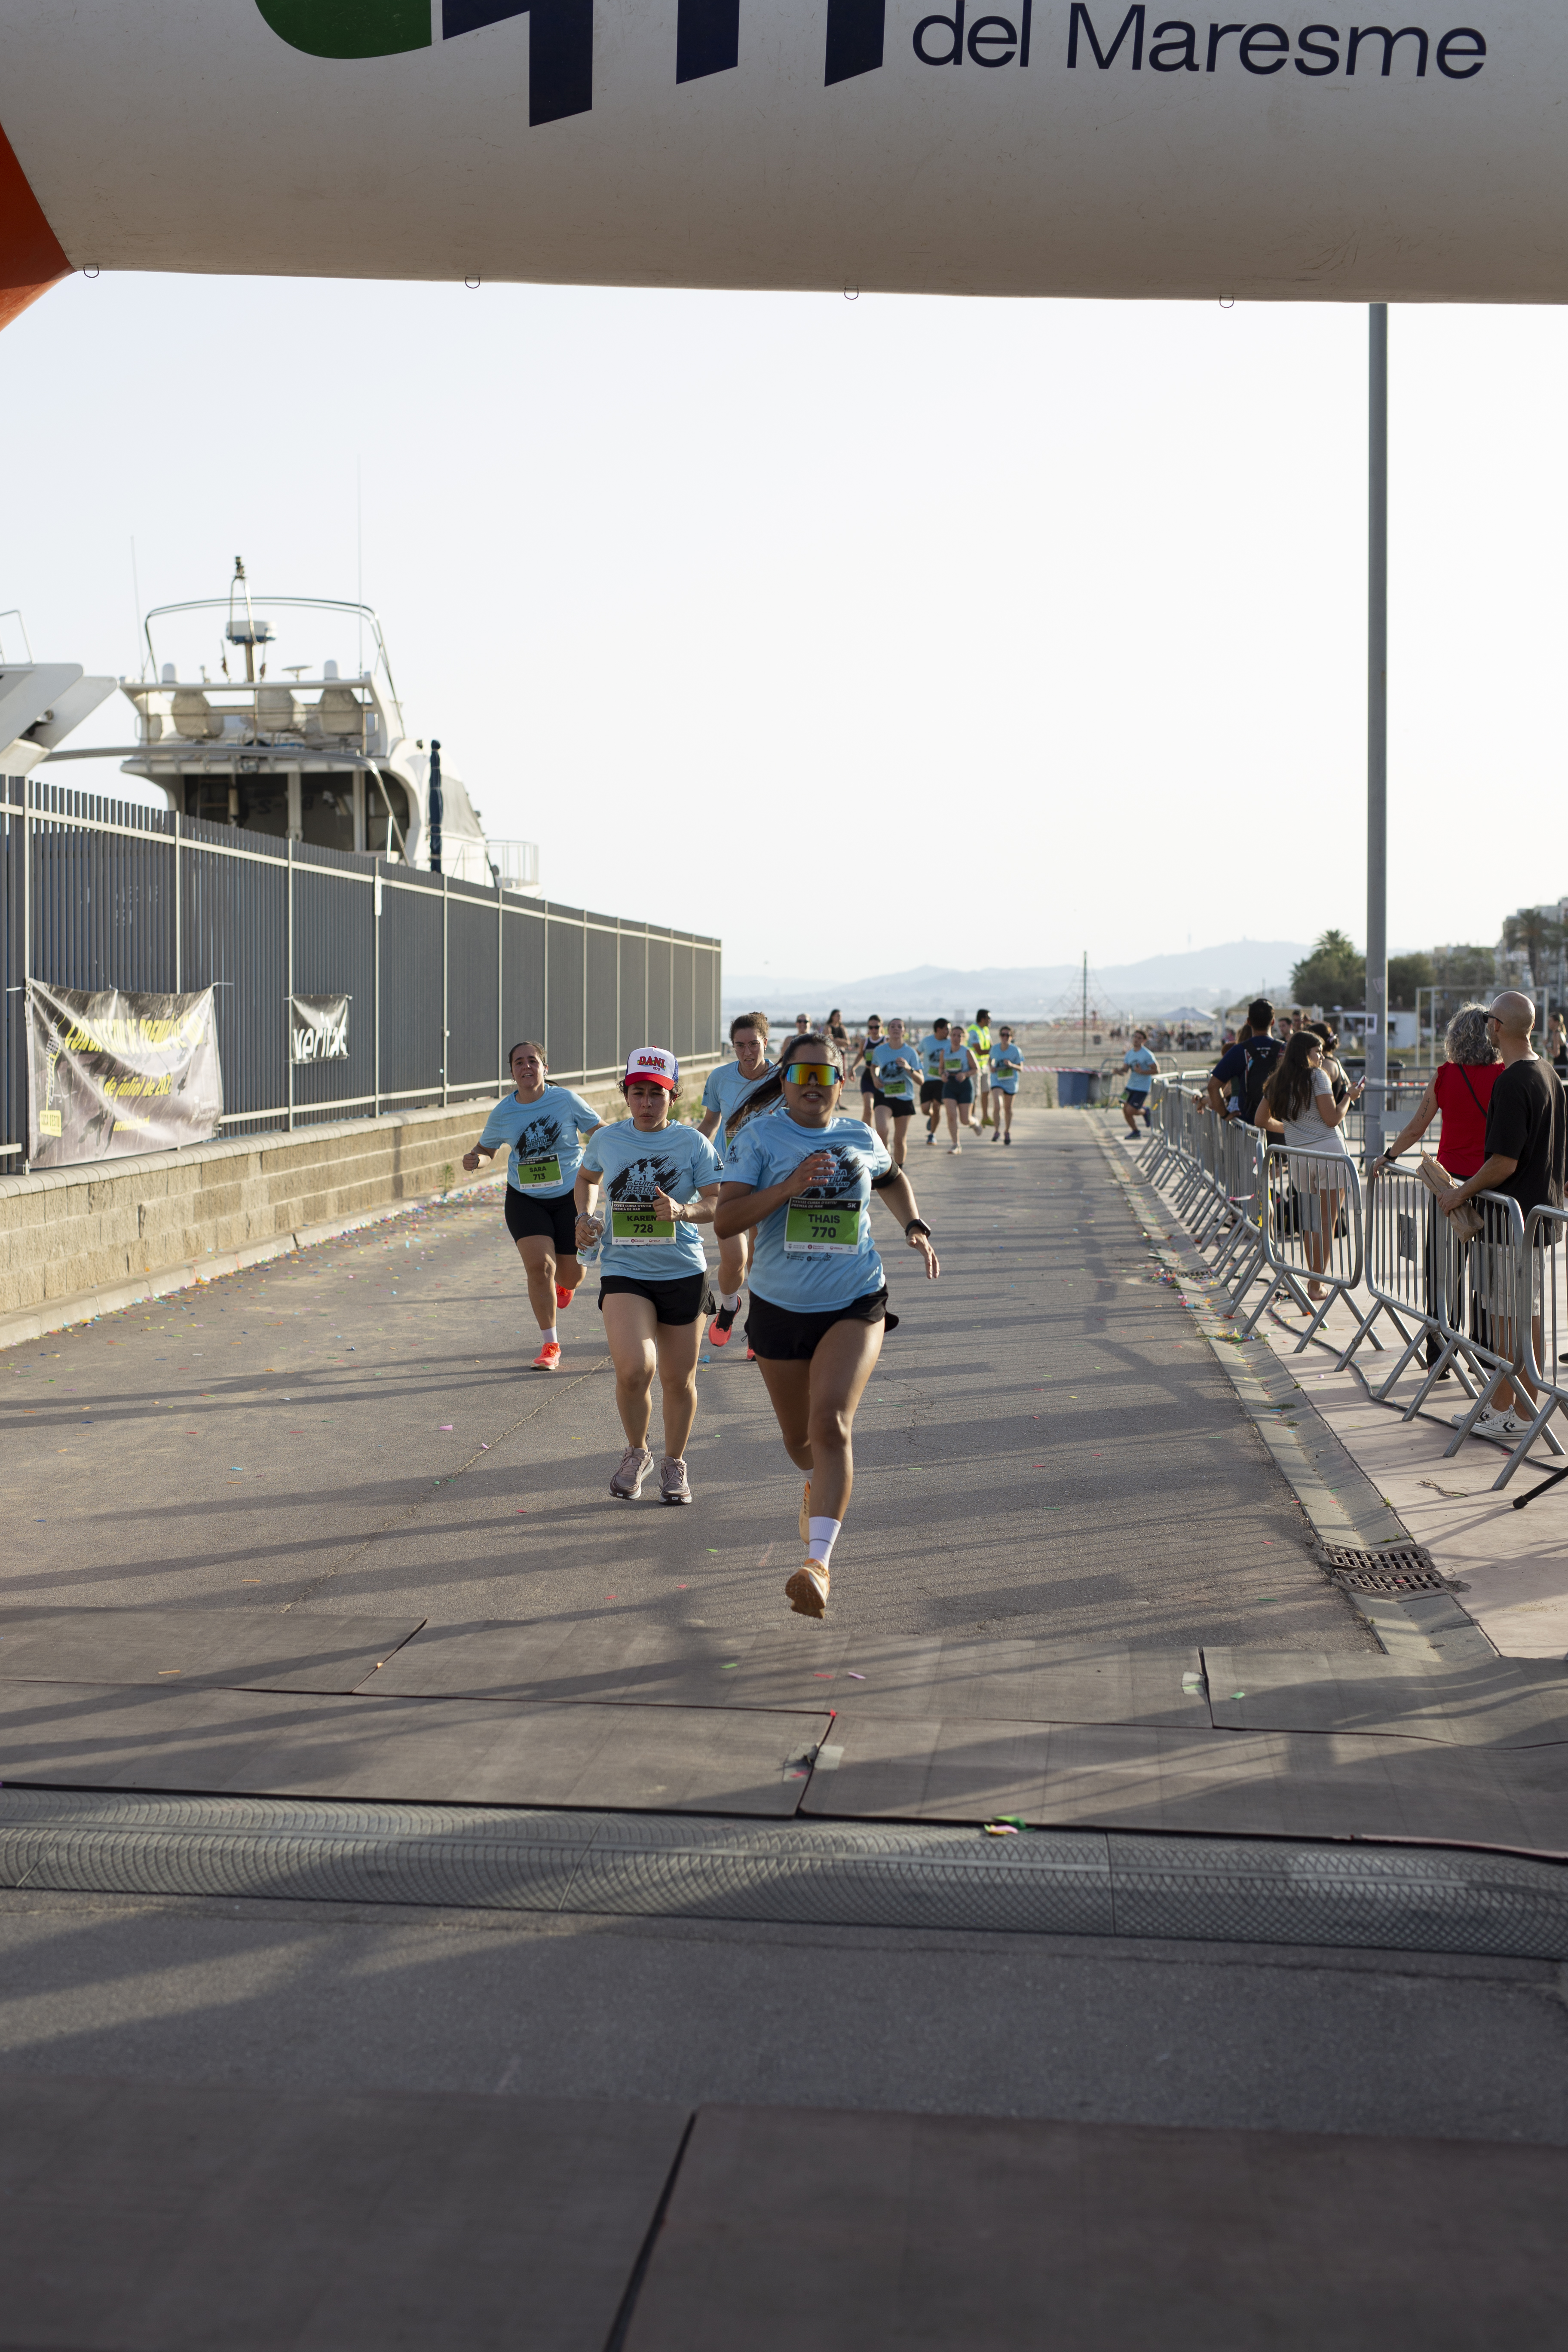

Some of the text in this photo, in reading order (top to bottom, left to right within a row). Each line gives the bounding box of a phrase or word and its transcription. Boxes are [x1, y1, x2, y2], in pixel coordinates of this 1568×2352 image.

[912, 0, 1031, 67] del
[1066, 2, 1487, 80] Maresme
[638, 1056, 665, 1069] DANI
[104, 1076, 117, 1096] de
[113, 1077, 146, 1102] juliol
[143, 1076, 155, 1096] de
[531, 1135, 549, 1143] CURSA
[808, 1214, 840, 1224] THAIS
[633, 1224, 654, 1233] 728
[811, 1226, 836, 1238] 770
